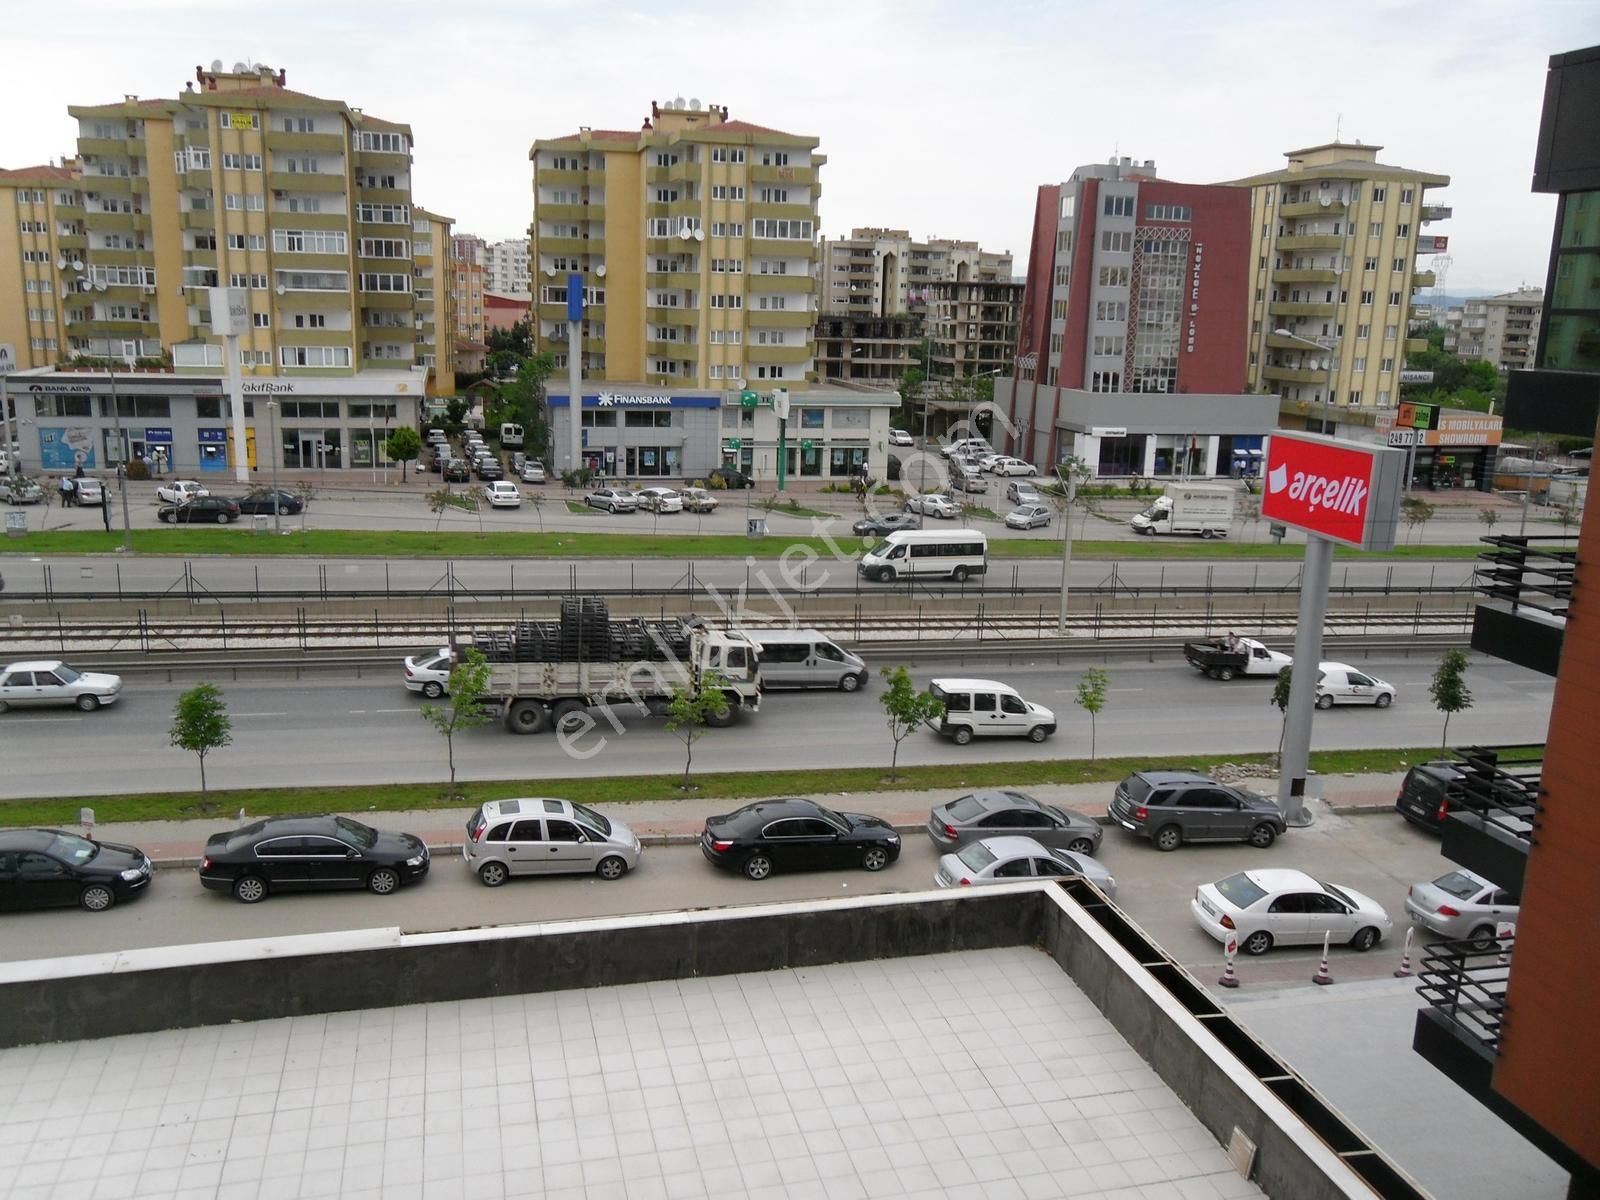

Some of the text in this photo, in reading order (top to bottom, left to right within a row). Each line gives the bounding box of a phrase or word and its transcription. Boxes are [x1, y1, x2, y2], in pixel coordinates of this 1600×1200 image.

[1192, 242, 1203, 300] merkezi
[613, 393, 672, 405] FINANSBANK
[1390, 432, 1403, 444] 249
[1439, 433, 1488, 445] SHOWROOM
[1288, 471, 1368, 517] arçelik
